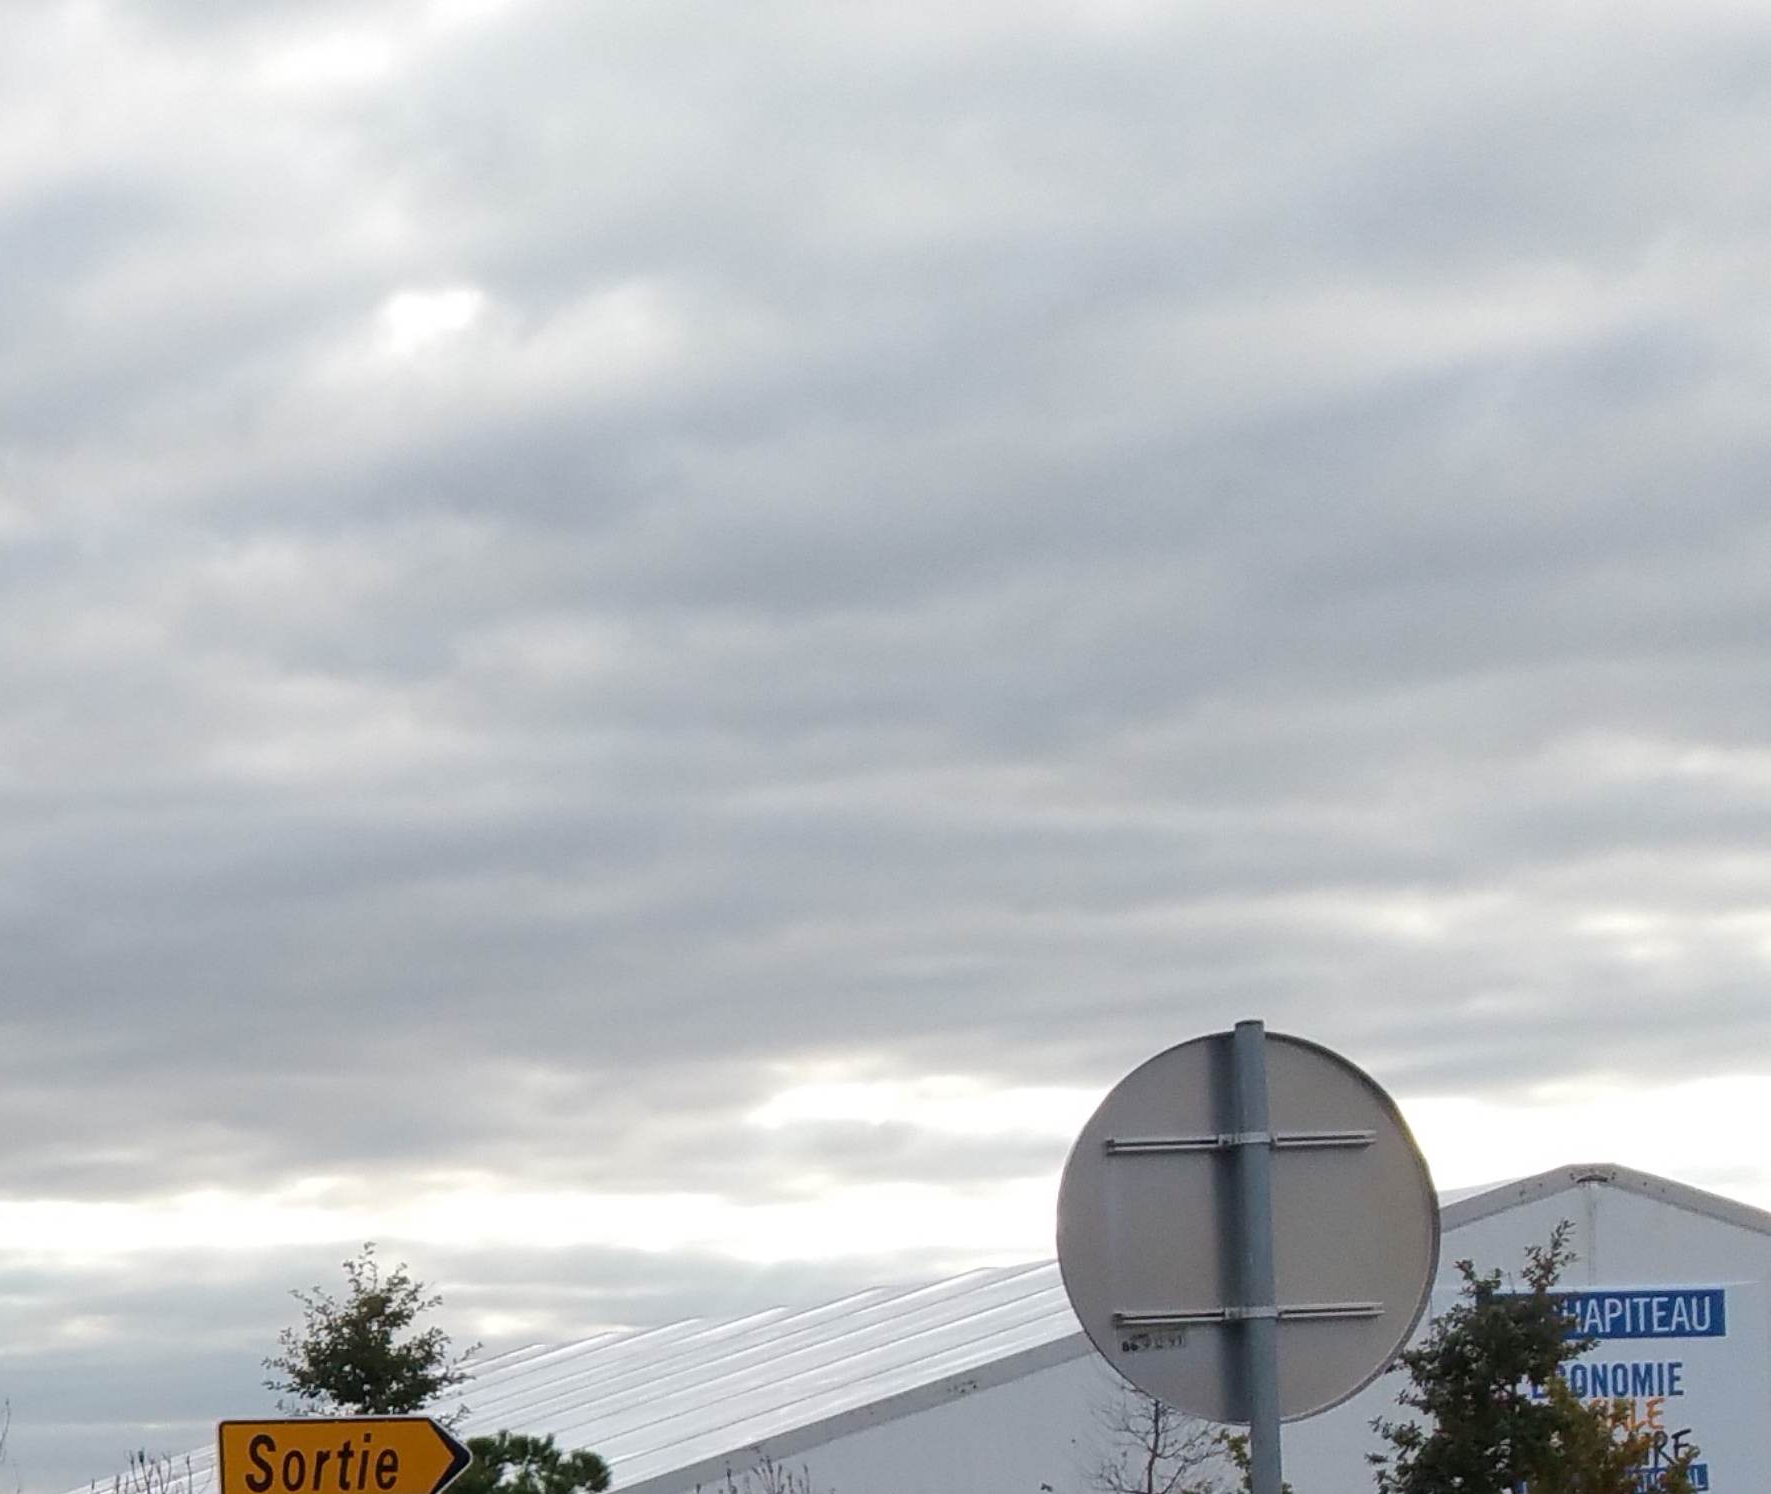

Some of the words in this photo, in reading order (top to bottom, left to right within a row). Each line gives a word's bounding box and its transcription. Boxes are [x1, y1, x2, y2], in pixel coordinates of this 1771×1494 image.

[1559, 1296, 1711, 1334] HAPITEAU
[1532, 1361, 1684, 1399] ONOMIE
[244, 1432, 399, 1493] Sortie
